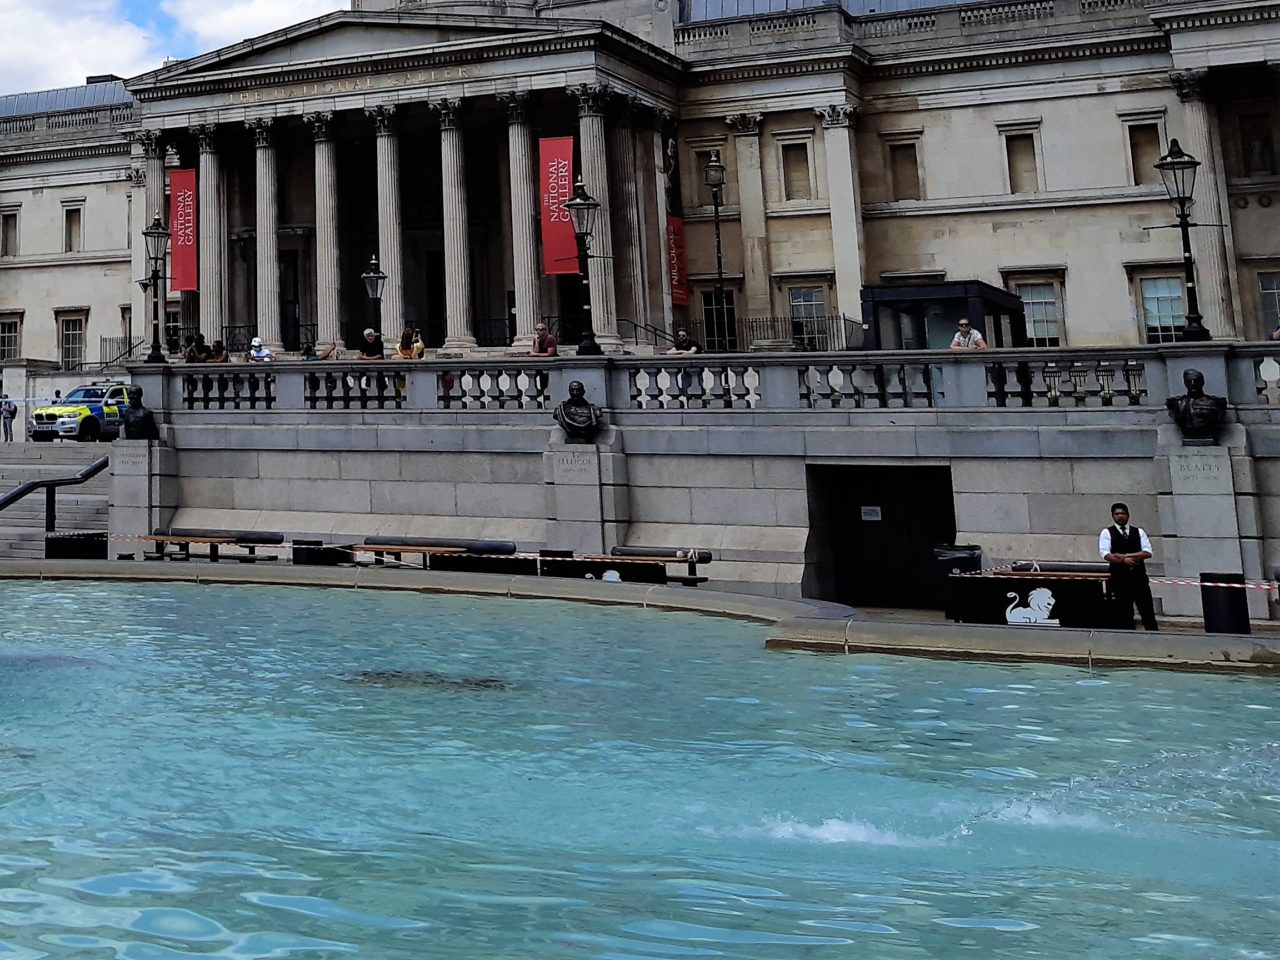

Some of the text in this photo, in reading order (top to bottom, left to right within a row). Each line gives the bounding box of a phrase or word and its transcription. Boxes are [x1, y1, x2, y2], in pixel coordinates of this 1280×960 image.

[227, 91, 262, 104] THE
[274, 77, 374, 98] NATIONAL
[177, 189, 185, 245] NATIONAL
[185, 189, 193, 245] GALLERY
[549, 158, 559, 222] NATIONAL
[559, 159, 570, 222] GALLERY
